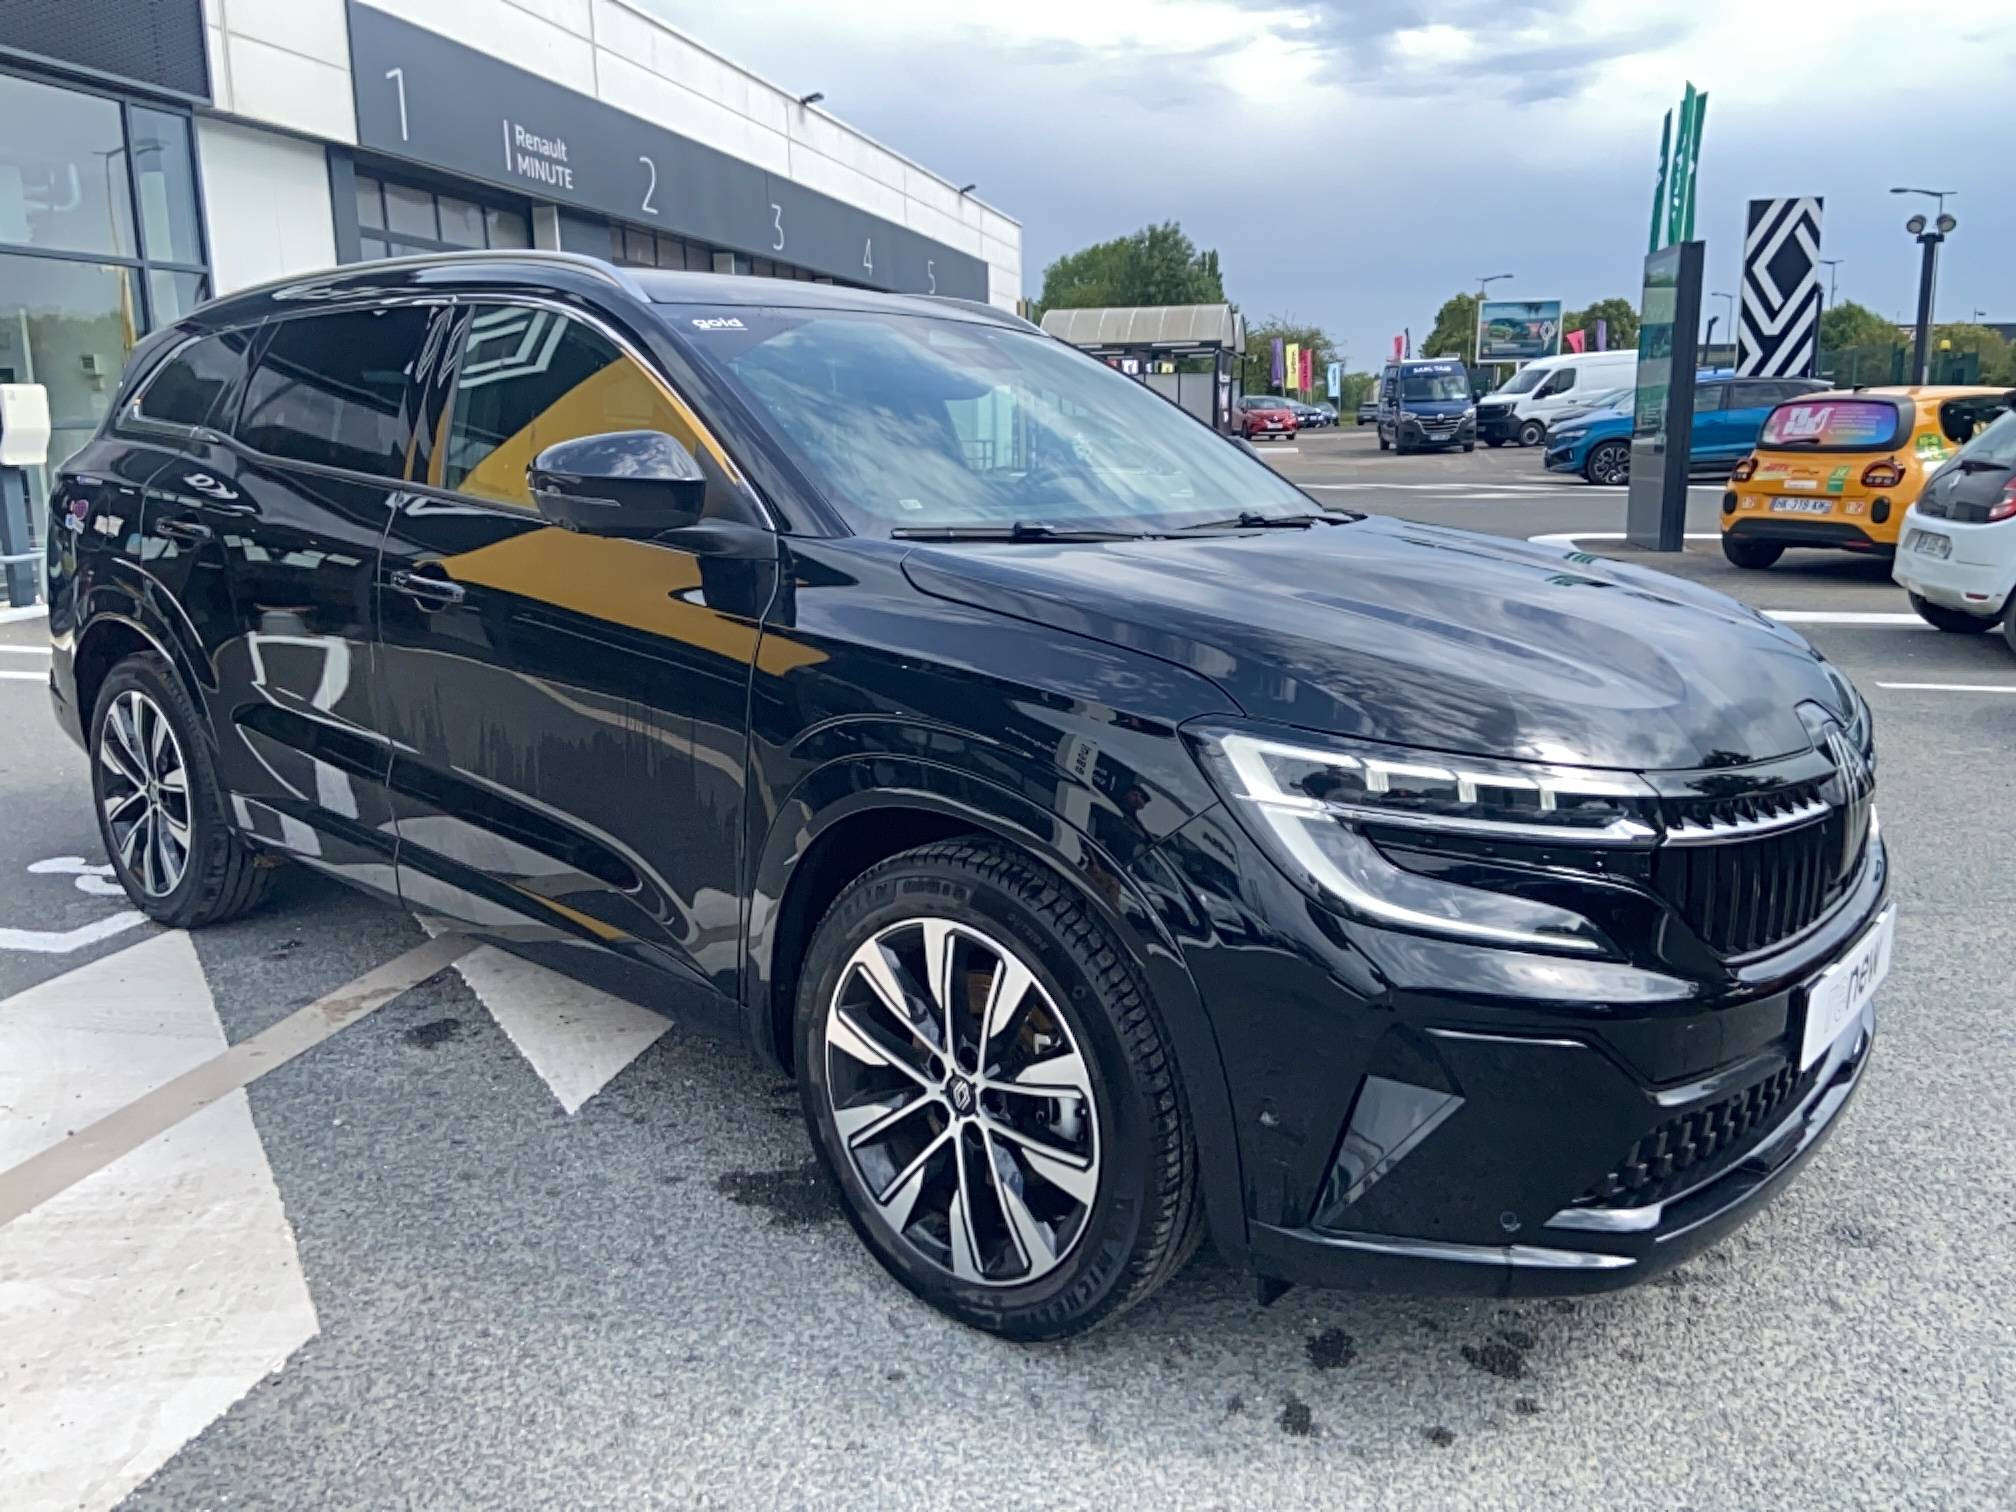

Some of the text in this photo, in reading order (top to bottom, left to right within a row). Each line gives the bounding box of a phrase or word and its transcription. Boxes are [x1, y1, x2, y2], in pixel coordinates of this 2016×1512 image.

[385, 67, 408, 141] 1
[514, 123, 568, 162] Renault
[517, 153, 574, 190] MINUTE
[639, 156, 659, 215] 2
[771, 203, 785, 251] 3
[863, 237, 873, 277] 4
[927, 259, 937, 295] 5
